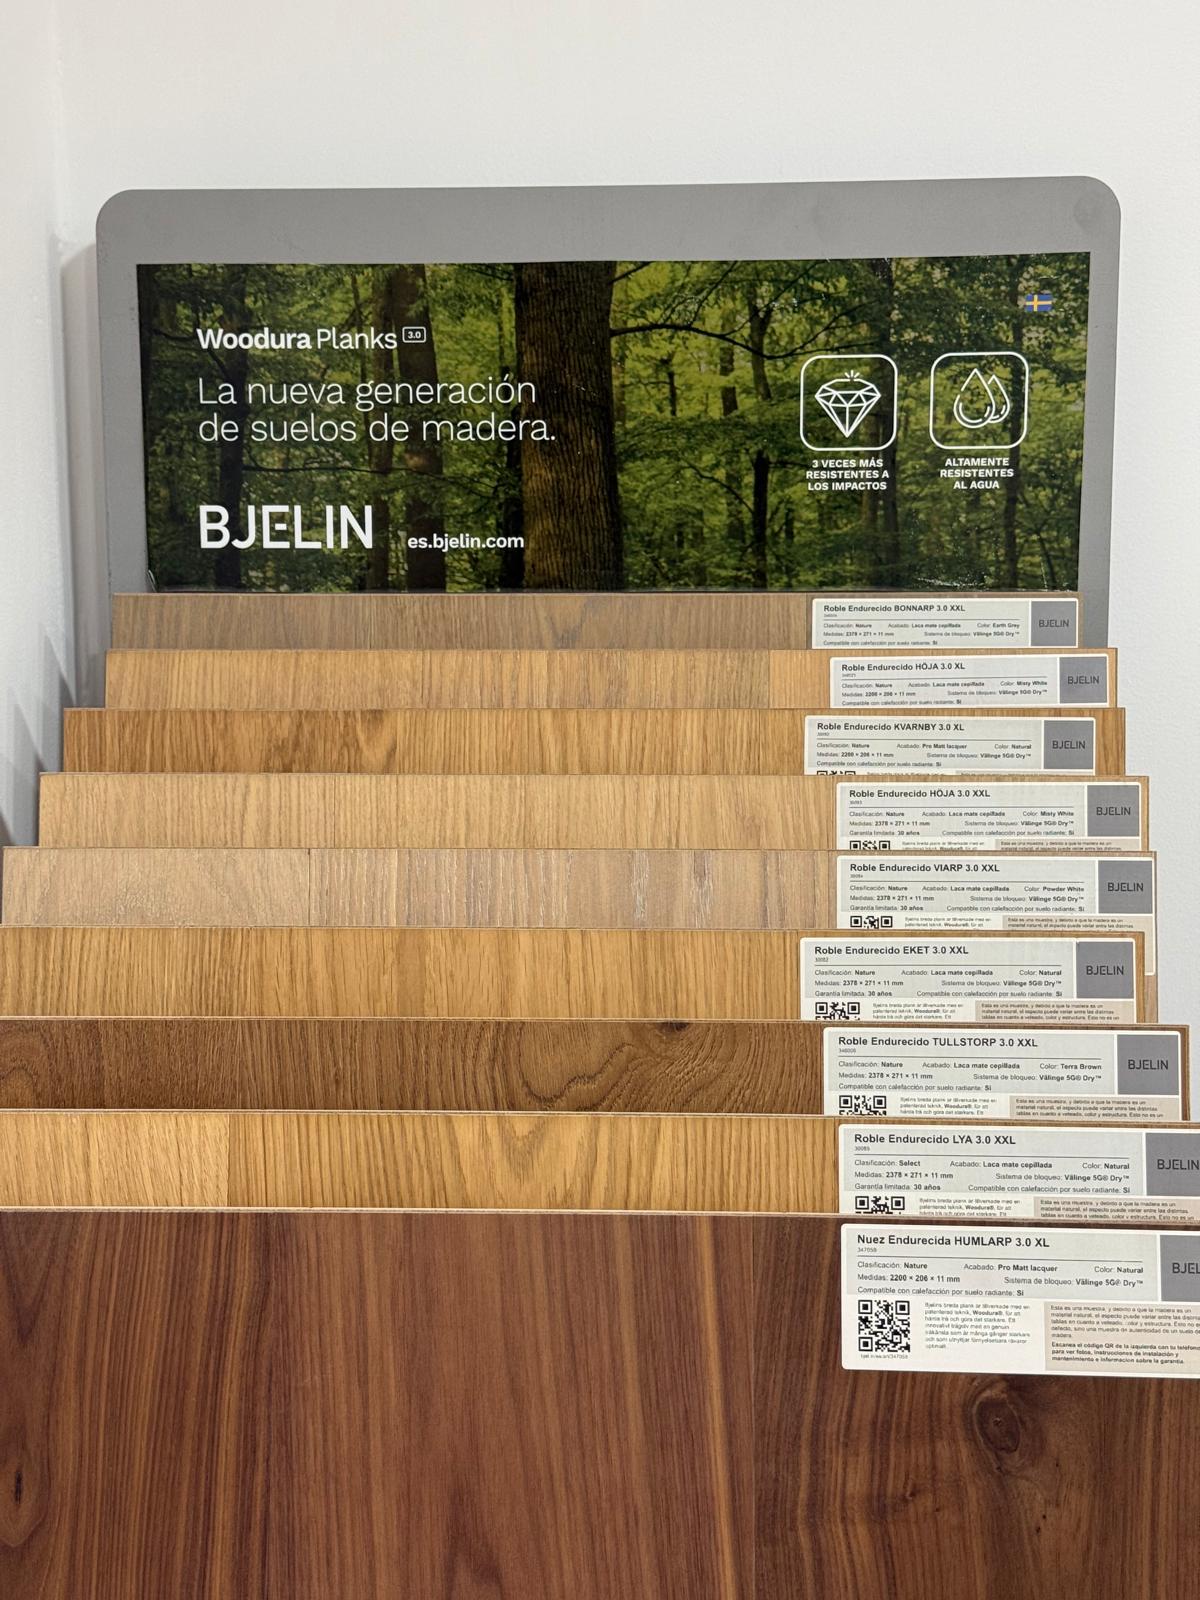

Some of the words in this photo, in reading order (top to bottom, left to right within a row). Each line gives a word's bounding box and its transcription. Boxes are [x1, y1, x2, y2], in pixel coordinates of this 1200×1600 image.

[197, 328, 311, 349] Woodura
[317, 329, 397, 349] Planks
[199, 378, 236, 404] La
[248, 382, 345, 404] nueva
[356, 375, 535, 412] generación
[199, 413, 238, 441] de
[251, 414, 356, 441] suelos
[369, 414, 409, 441] de
[423, 414, 555, 441] madera.
[821, 460, 856, 468] VECES
[859, 457, 883, 467] MÁS
[946, 458, 1009, 466] ALTAMENTE
[806, 470, 878, 478] RESISTENTES
[882, 470, 889, 478] A
[940, 469, 1014, 477] RESISTENTES
[808, 482, 829, 490] LOS
[832, 482, 887, 490] IMPACTOS
[954, 481, 968, 489] AL
[970, 481, 999, 489] AGUA
[200, 505, 372, 550] BJELIN
[408, 533, 524, 552] es.bjelin.com
[1038, 619, 1070, 628] BJELIN
[915, 662, 938, 670] HÖJA
[1067, 675, 1099, 685] BJELIN
[816, 723, 841, 731] Roble
[843, 723, 891, 731] Endurecido
[893, 723, 936, 731] KVARNBY
[938, 723, 951, 731] 3.0
[953, 723, 964, 731] XL
[1052, 740, 1086, 750] BJELIN
[849, 790, 874, 798] Roble
[876, 790, 927, 798] Endurecido
[929, 789, 955, 798] HÖJA
[957, 790, 970, 798] 3.0
[972, 790, 990, 798] XXL
[1096, 806, 1131, 816] BJELIN
[850, 864, 876, 872] Roble
[878, 864, 931, 872] Endurecido
[933, 864, 962, 872] VIARP
[965, 864, 978, 872] 3.0
[981, 864, 999, 872] XXL
[1107, 882, 1144, 892] BJELIN
[814, 946, 842, 955] Roble
[845, 946, 900, 955] Endurecido
[902, 946, 930, 955] EKET
[932, 946, 946, 955] 3.0
[948, 946, 969, 955] XXL
[1086, 965, 1124, 976] BJELIN
[838, 1037, 867, 1047] Roble
[870, 1037, 929, 1047] Endurecido
[932, 1038, 996, 1047] TULLSTORP
[999, 1038, 1014, 1048] 3.0
[1016, 1038, 1038, 1048] XXL
[1128, 1059, 1169, 1070] BJELIN
[854, 1134, 884, 1143] Roble
[888, 1134, 949, 1144] Endurecido
[952, 1135, 972, 1144] LYA
[975, 1135, 990, 1145] 3.0
[994, 1135, 1016, 1145] XXL
[1020, 1162, 1053, 1170] cepillada
[1157, 1159, 1200, 1170] BJELIN
[1064, 1174, 1091, 1183] Välinge
[857, 1234, 884, 1245] Nuez
[888, 1235, 950, 1246] Endurecida
[954, 1236, 1012, 1247] HUMLARP
[1015, 1237, 1031, 1247] 3.0
[1034, 1237, 1049, 1247] XL
[1030, 1264, 1058, 1273] lacquer
[1075, 1278, 1103, 1287] Välinge
[857, 1287, 895, 1296] Compatible
